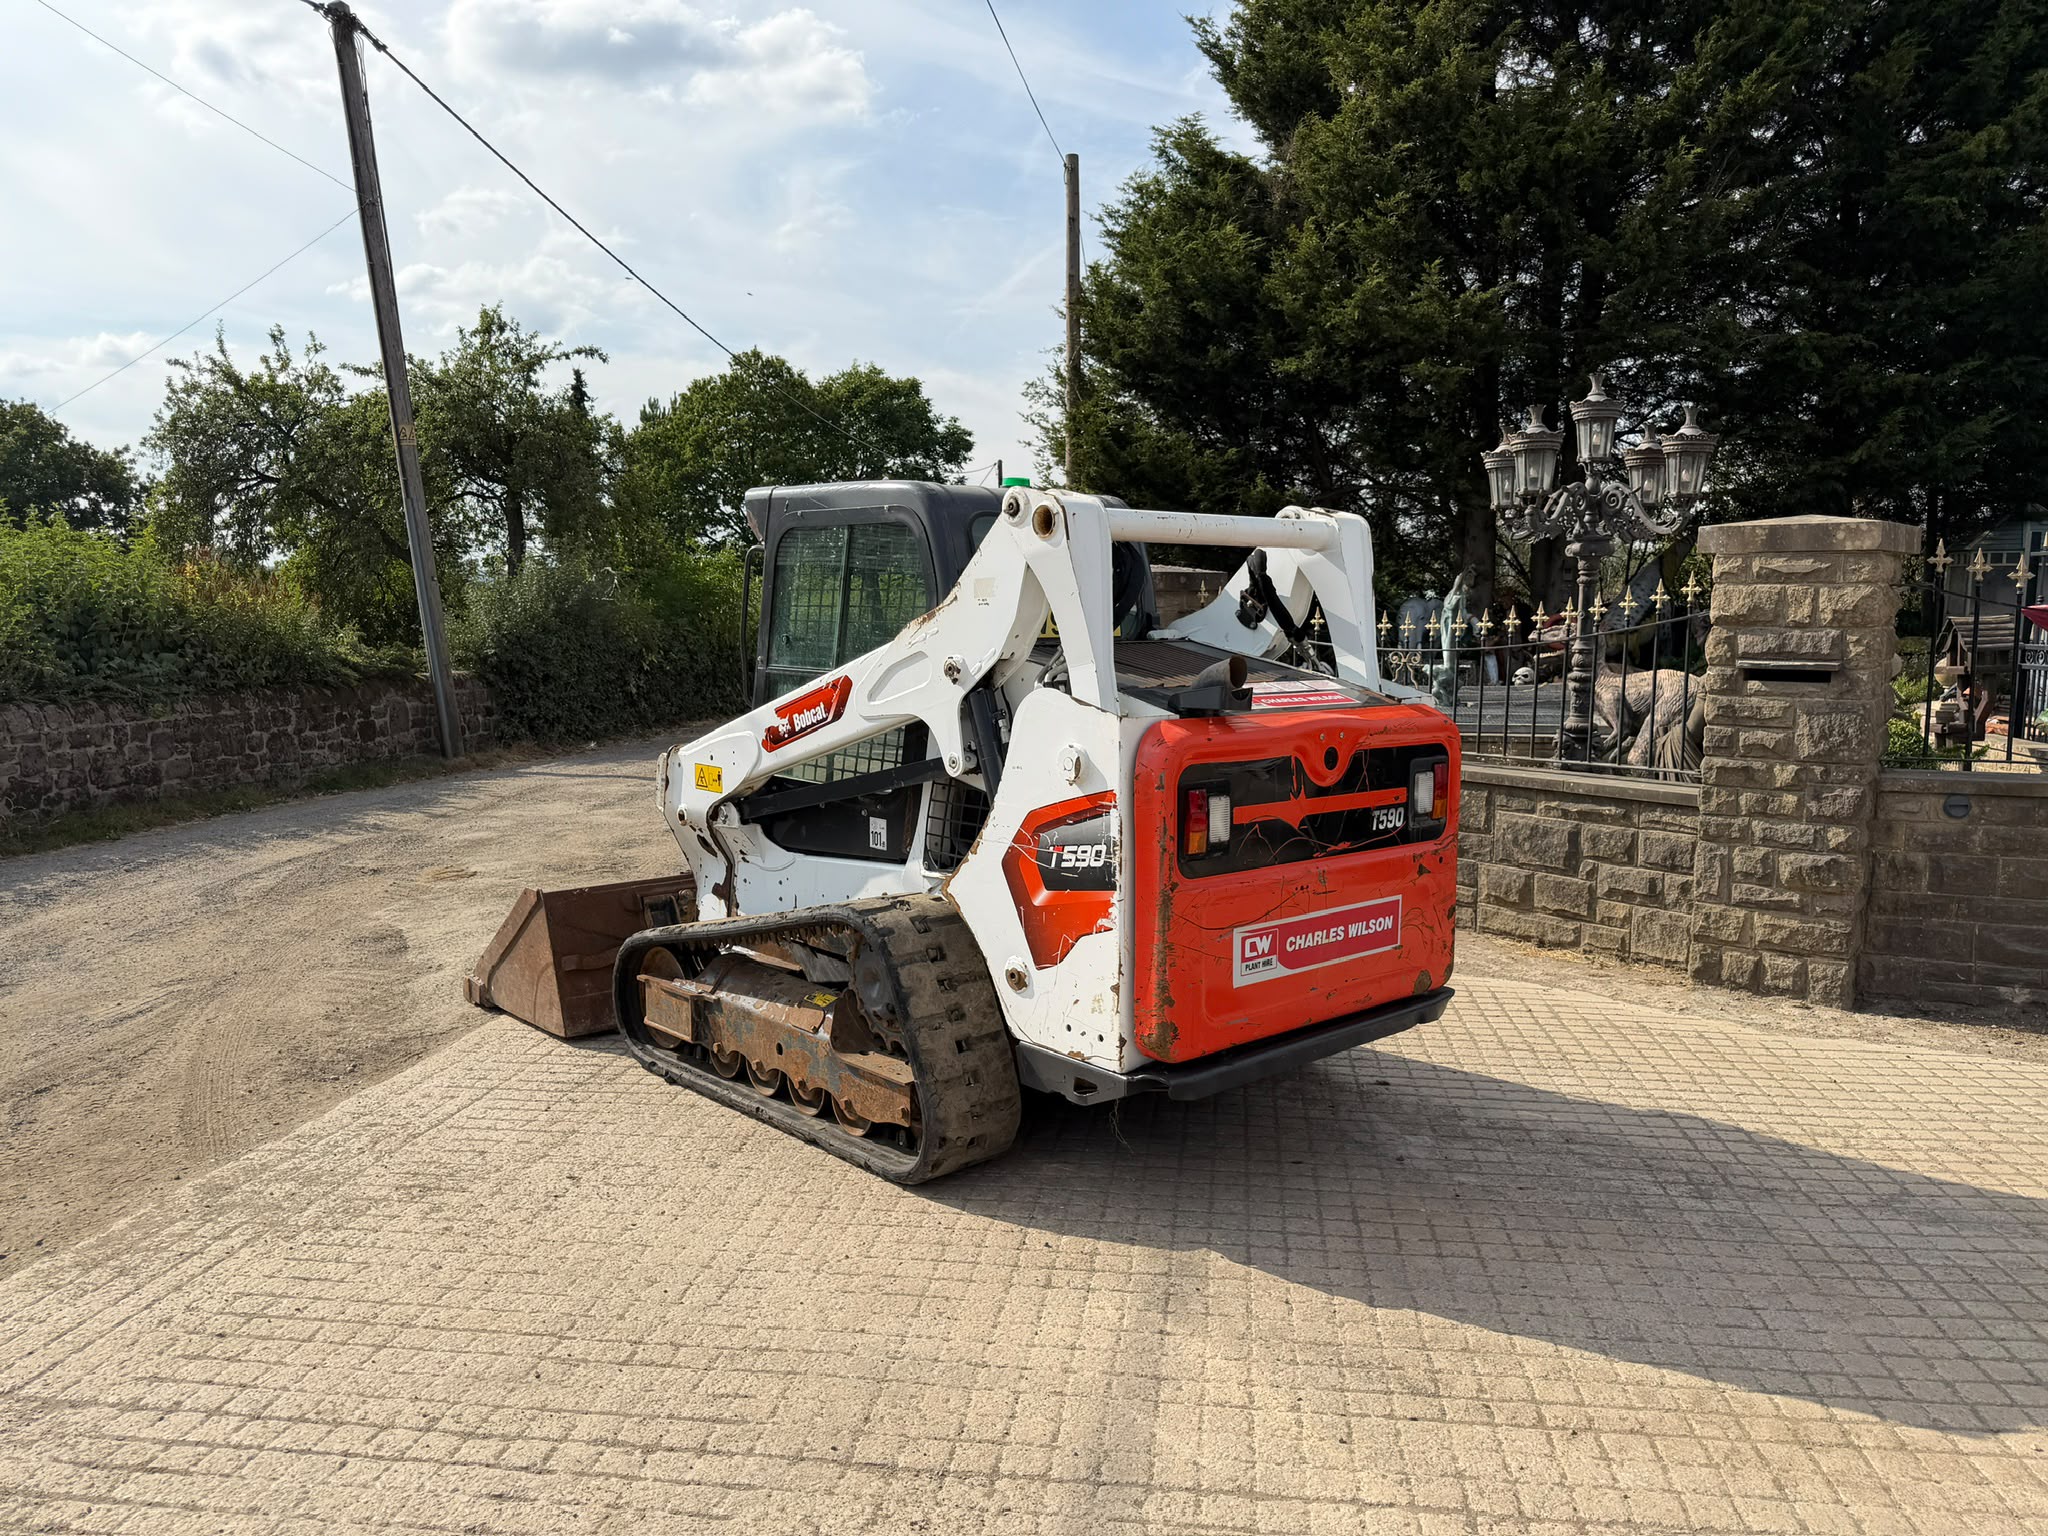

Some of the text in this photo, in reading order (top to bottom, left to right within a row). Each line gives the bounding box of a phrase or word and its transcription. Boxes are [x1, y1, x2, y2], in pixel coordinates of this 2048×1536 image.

[792, 701, 827, 732] Bobcat
[1372, 807, 1405, 831] T590
[871, 831, 882, 847] 101
[1049, 844, 1107, 868] T590
[1285, 915, 1394, 952] CHARLES WILSON
[1245, 934, 1273, 958] CW
[1245, 958, 1273, 972] PLANT HIRE
